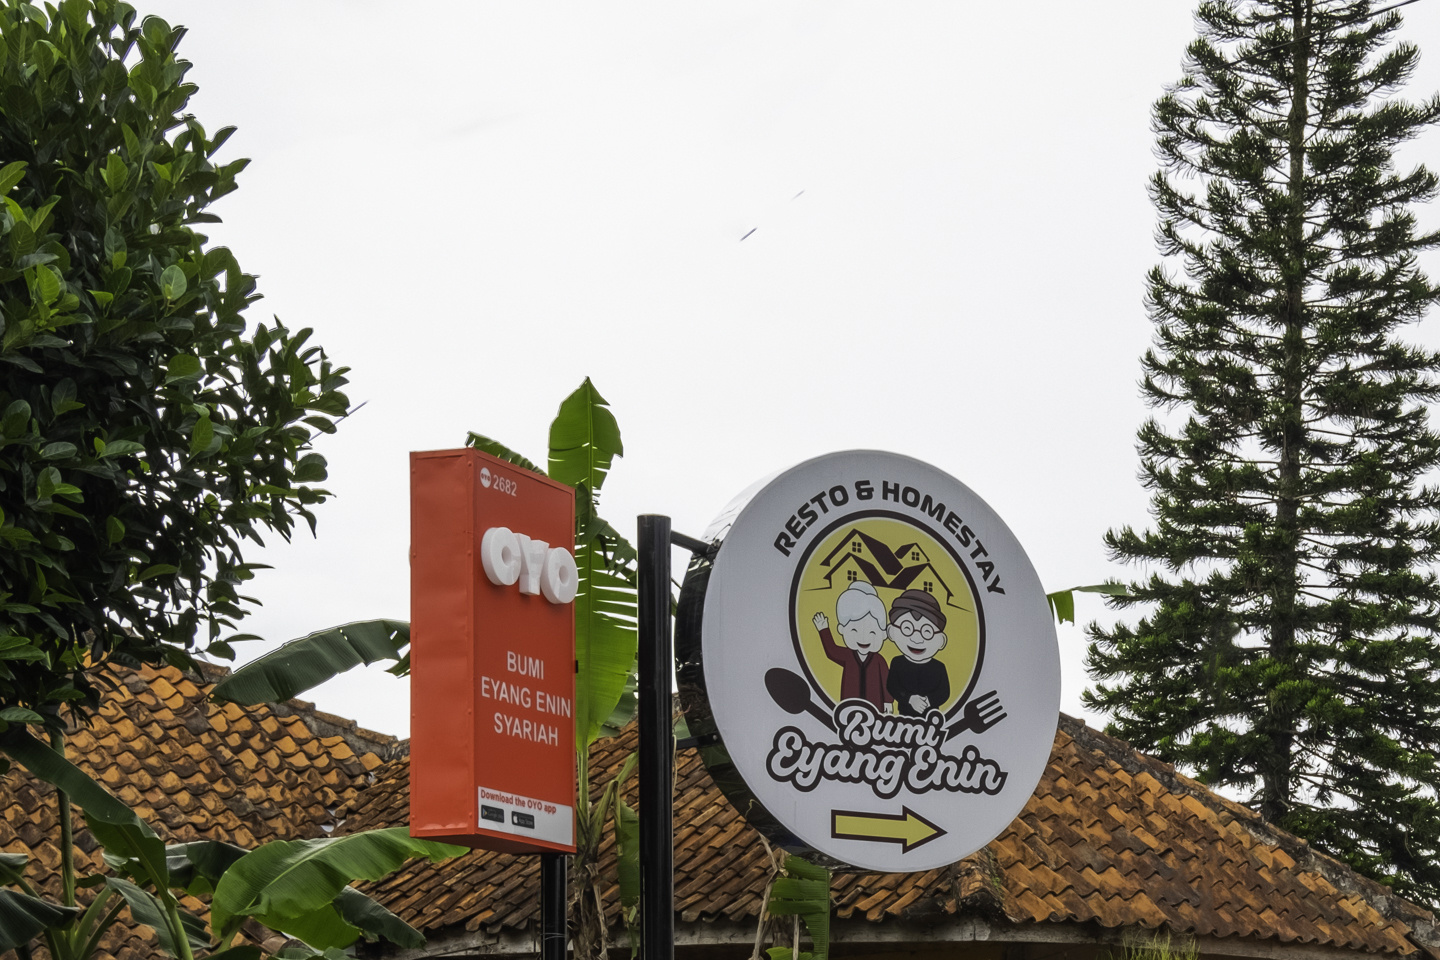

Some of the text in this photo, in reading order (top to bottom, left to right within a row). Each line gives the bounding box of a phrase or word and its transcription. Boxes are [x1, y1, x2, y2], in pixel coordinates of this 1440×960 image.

[493, 474, 518, 497] 2682
[773, 479, 1006, 597] RESTO & HOMESTAY
[481, 526, 579, 604] OYO
[507, 651, 544, 680] BUMI
[482, 675, 571, 718] EYANG ENIN
[494, 712, 558, 747] SYARIAH
[836, 702, 945, 749] Bumi
[768, 729, 1004, 797] Eyang Enin
[480, 789, 557, 815] Download the OYO app
